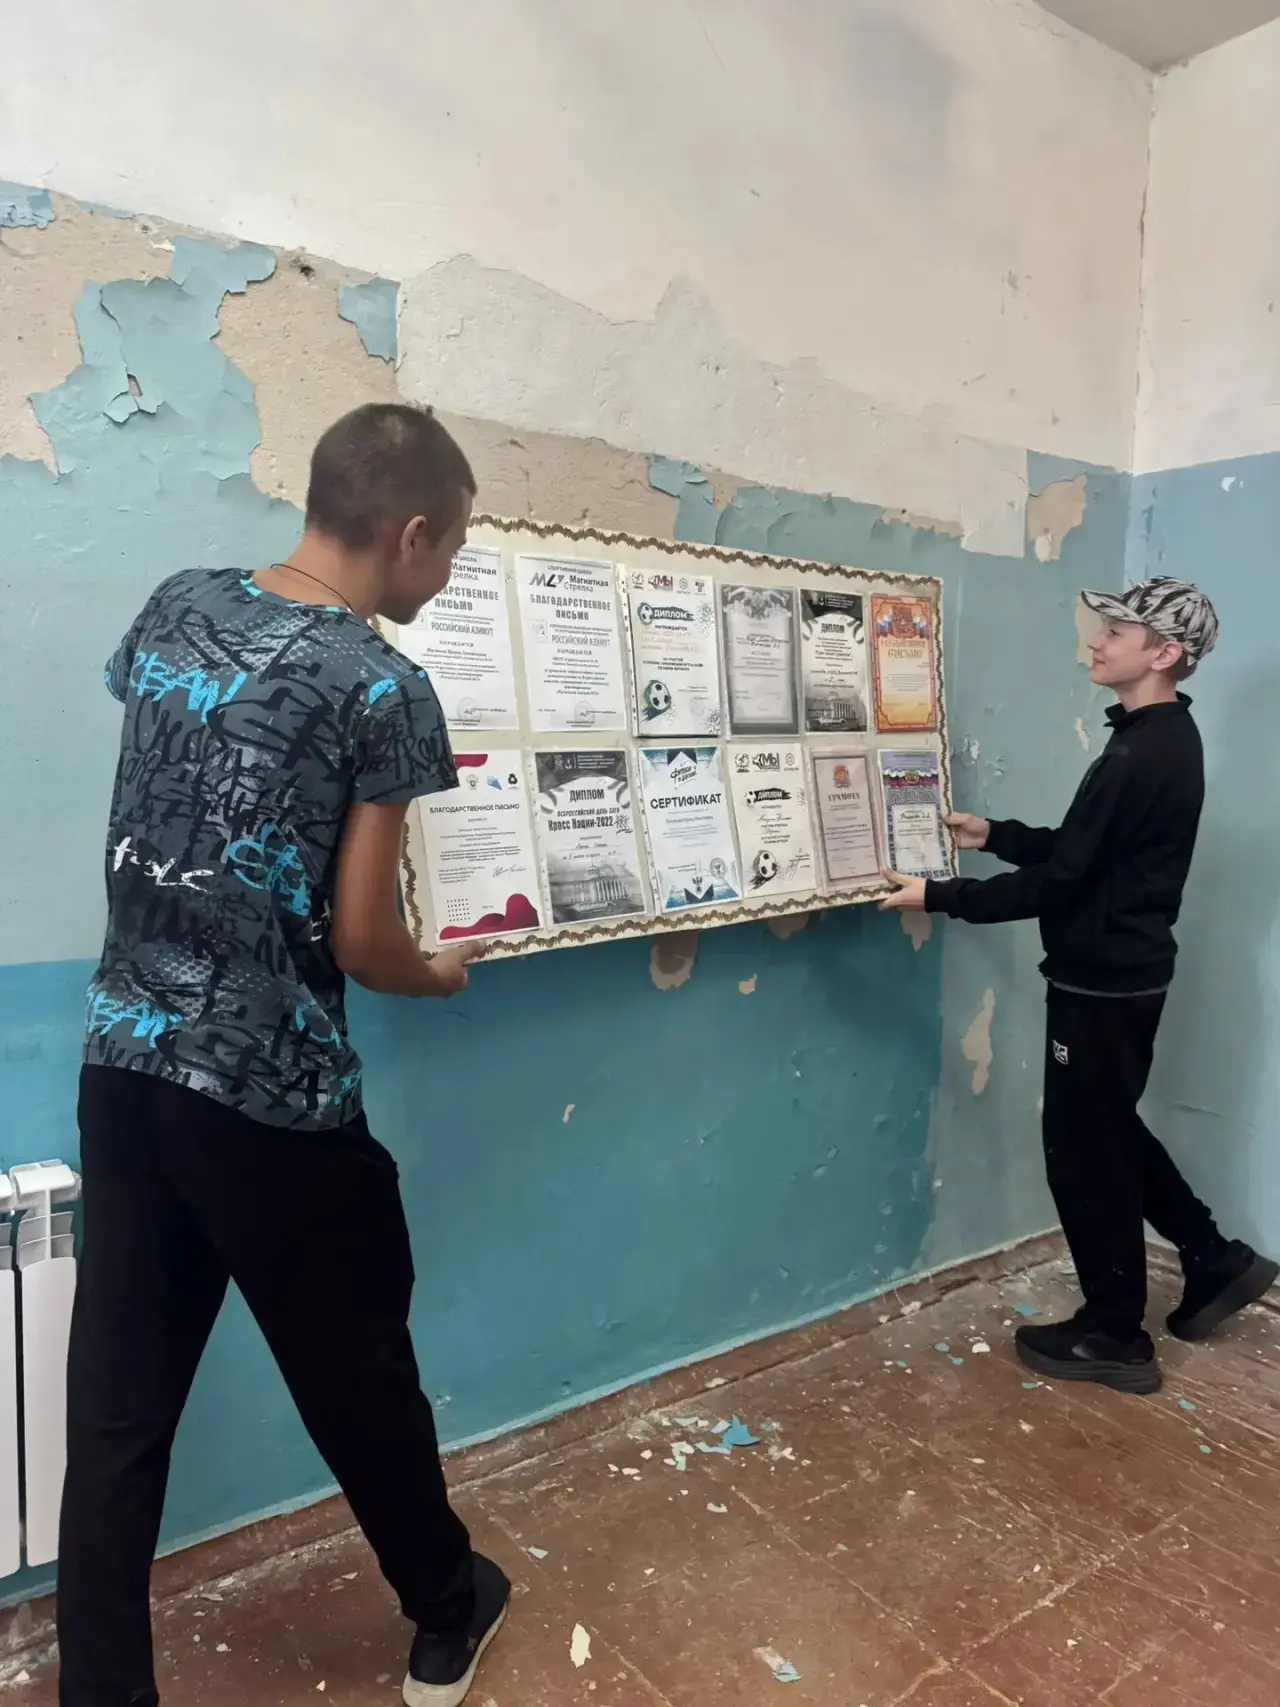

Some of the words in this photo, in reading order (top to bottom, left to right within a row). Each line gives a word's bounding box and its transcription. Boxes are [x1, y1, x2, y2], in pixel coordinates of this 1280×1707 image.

[563, 581, 594, 592] Стрелка
[569, 574, 609, 587] Магнитная
[434, 598, 474, 611] ПИСЬМО
[530, 594, 612, 611] БЛАГОДАРСТВЕННОЕ
[555, 609, 590, 620] ПИСЬМО
[654, 609, 688, 619] ДИПЛОМ
[431, 621, 471, 634] РОССИЙСКИЙ
[551, 634, 589, 646] РОССИЙСКИЙ
[569, 788, 605, 803] ДИПЛОМ
[650, 793, 722, 810] СЕРТИФИКАТ
[429, 804, 494, 813] БЛАГОДАРСТВЕННОЕ
[494, 803, 520, 811] ПИСЬМО
[556, 807, 595, 818] ВСЕРОССИЙСКИЙ
[547, 819, 571, 832] Кросс
[571, 815, 614, 830] Нации-2022
